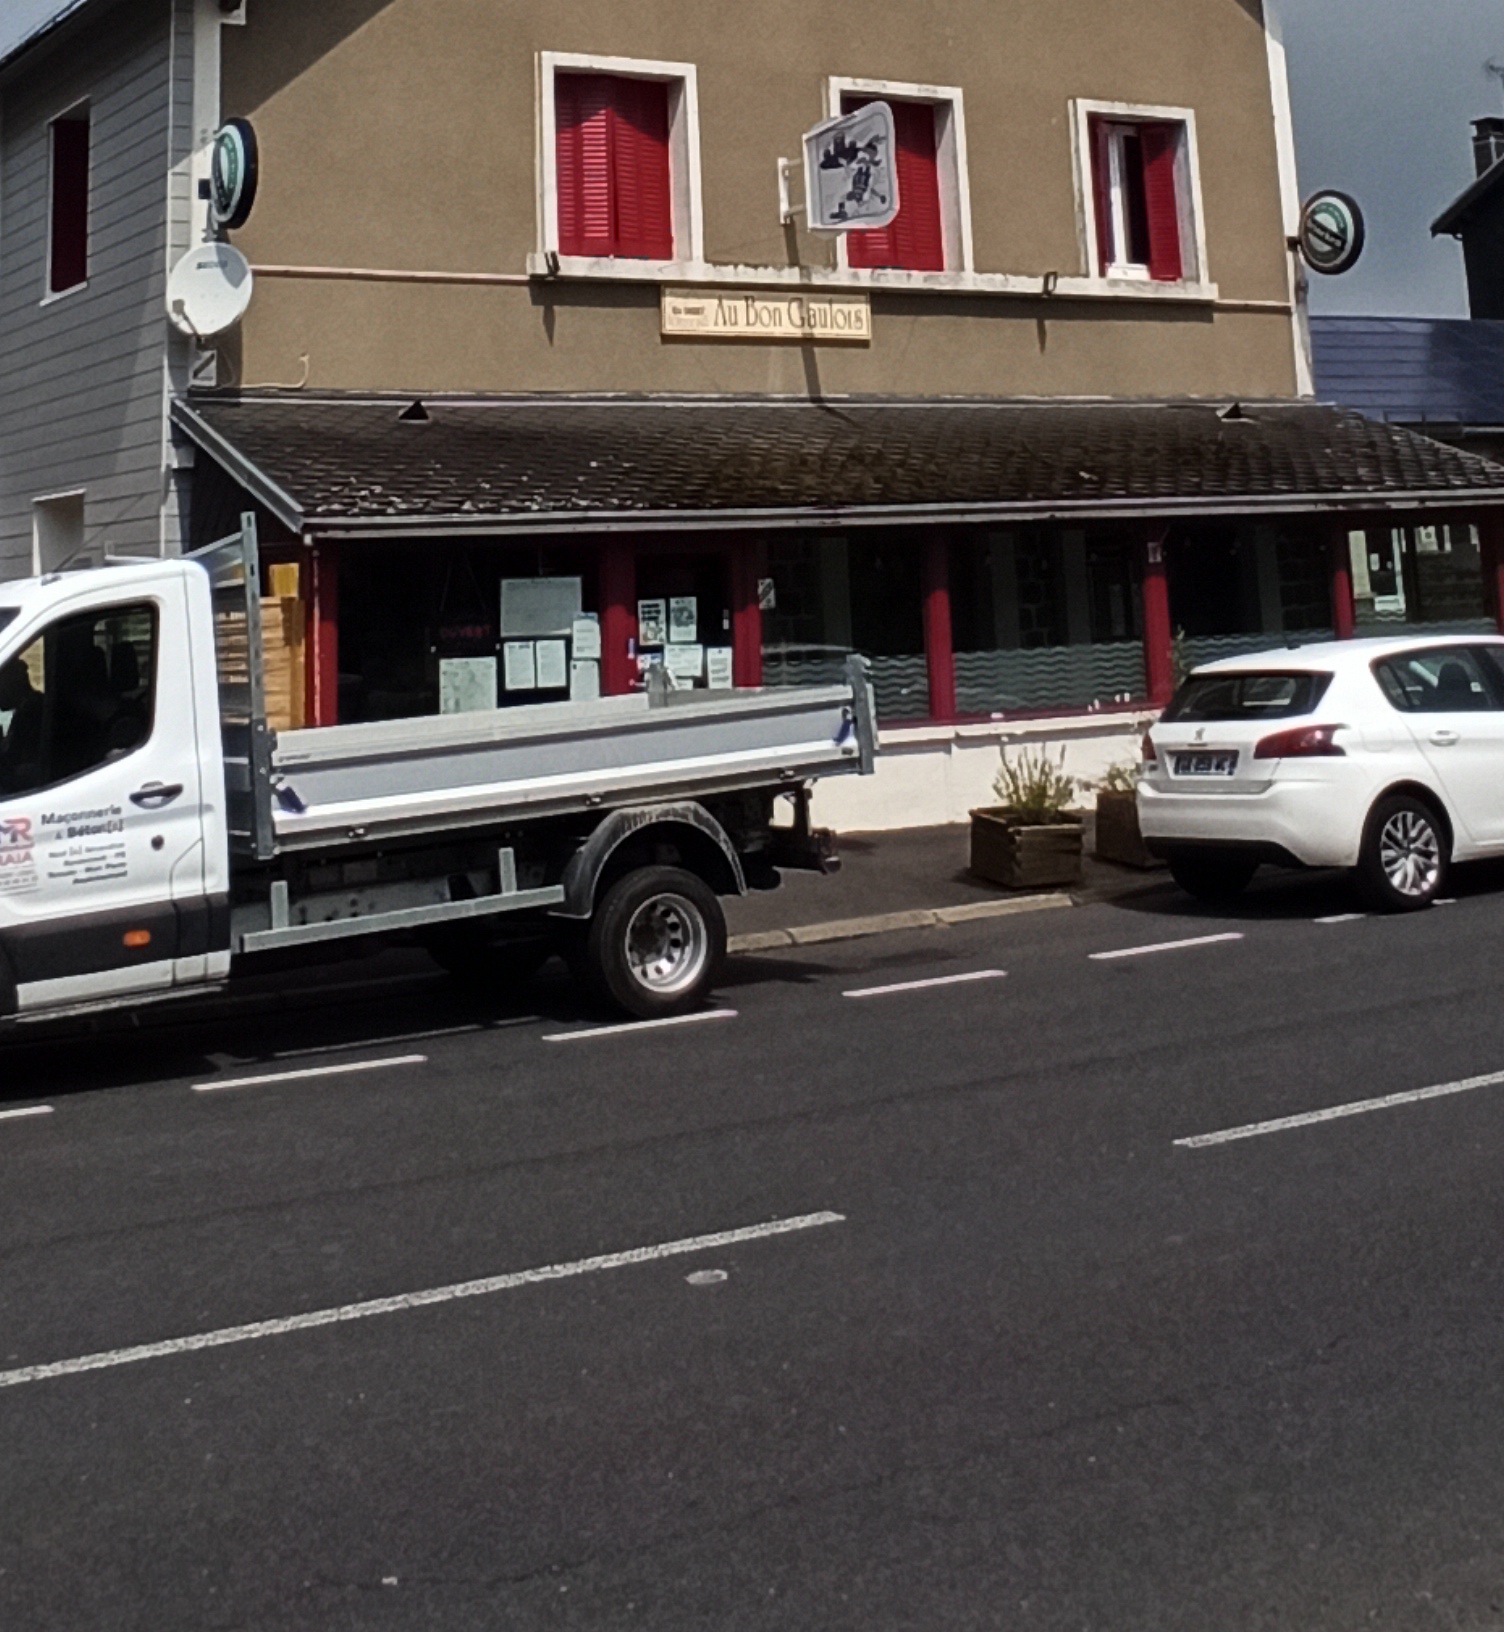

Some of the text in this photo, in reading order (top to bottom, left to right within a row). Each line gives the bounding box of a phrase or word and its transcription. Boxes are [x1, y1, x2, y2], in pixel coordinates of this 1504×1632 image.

[714, 295, 864, 331] Au Bon Gaulois
